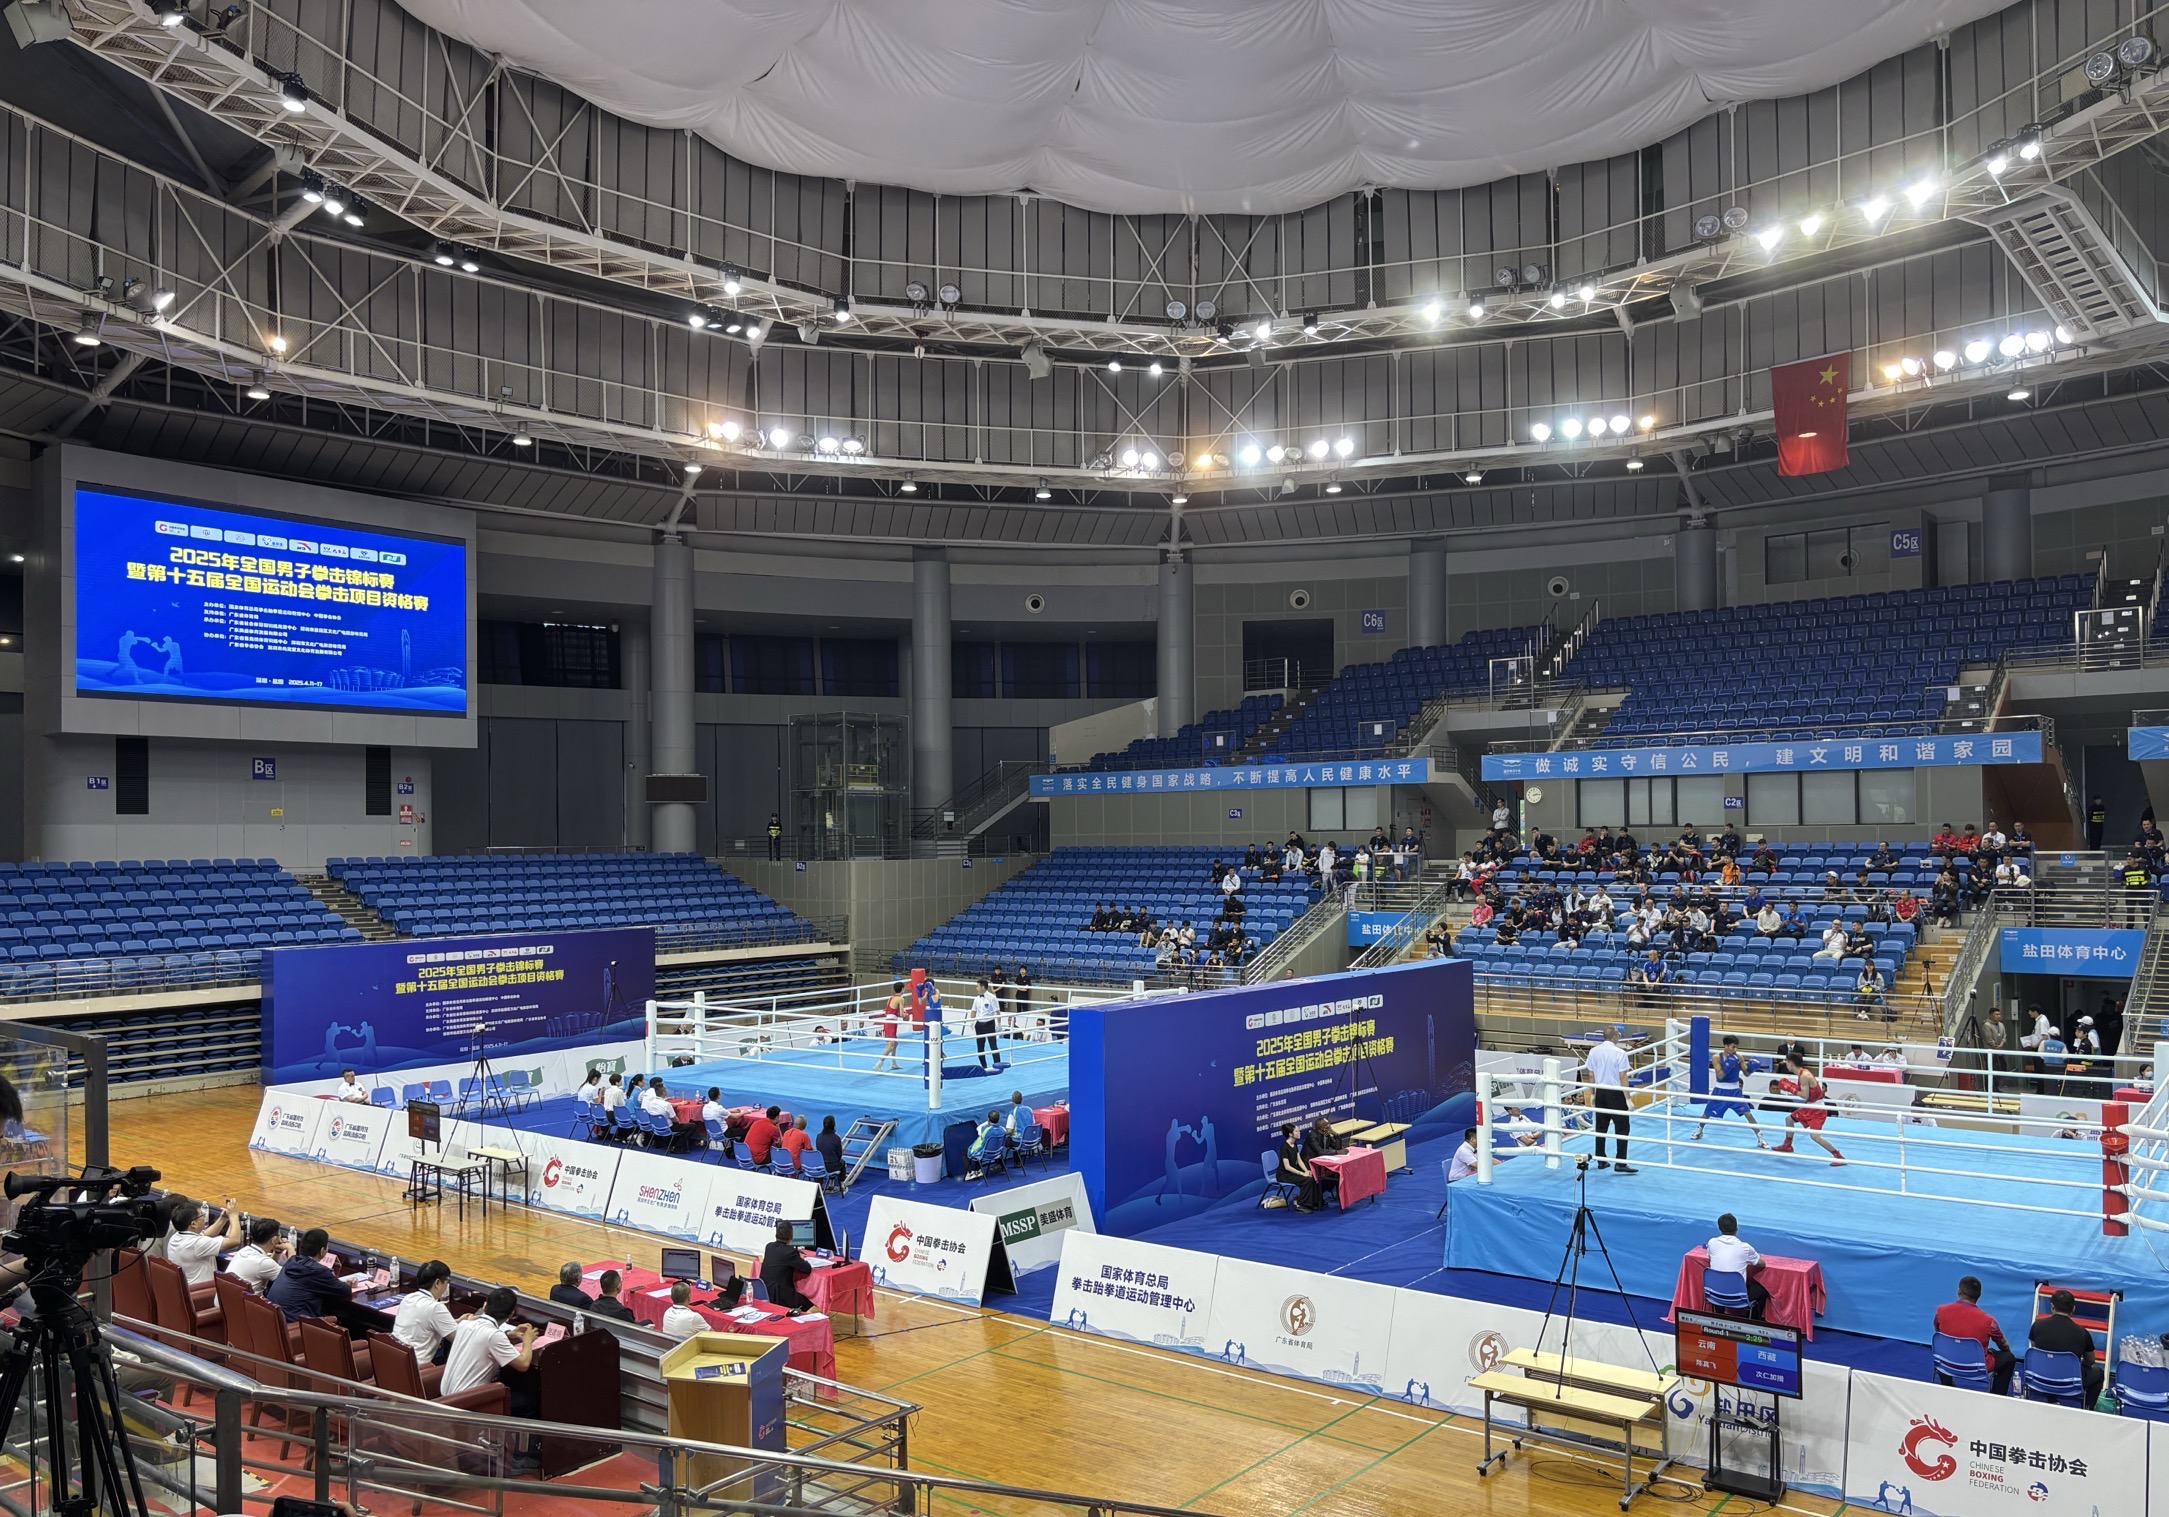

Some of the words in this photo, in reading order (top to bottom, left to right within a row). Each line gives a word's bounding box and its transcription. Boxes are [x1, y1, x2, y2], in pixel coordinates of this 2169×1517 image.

[1893, 534, 1918, 550] C5区
[170, 547, 395, 589] 2025年全国男子拳击锦标赛
[126, 561, 429, 612] 暨第十五届全国运动会拳击项目资格赛
[1364, 613, 1383, 627] C6区
[2022, 943, 2127, 960] 盐田体育中心
[418, 959, 544, 979] 2025年全国男子拳击锦标赛
[395, 969, 564, 995] 暨第十五届全国运动会拳击项目资格赛
[1256, 1019, 1376, 1057] 2025年全国男子拳击锦标赛
[564, 1164, 598, 1180] 中国拳击协会
[735, 1195, 782, 1215] 国家体育总局
[1001, 1215, 1036, 1237] MSSP
[1039, 1206, 1073, 1227] 美盛体育
[916, 1234, 967, 1255] 中国拳击协会
[913, 1253, 929, 1261] BOXING
[1100, 1264, 1169, 1290] 国家体育总局
[1071, 1276, 1196, 1314] 拳击跆拳道运动管理中心
[1275, 1335, 1314, 1351] 广东省体育局
[1703, 1326, 1724, 1336] Round
[1745, 1334, 1763, 1344] 2:29
[1697, 1339, 1716, 1351] 云南
[1757, 1350, 1777, 1362] 西藏
[1969, 1439, 2088, 1478] 中国拳击协会
[1969, 1460, 2005, 1475] CHINESE
[1969, 1469, 2004, 1483] BOXING
[1969, 1478, 2020, 1495] FEDERATION
